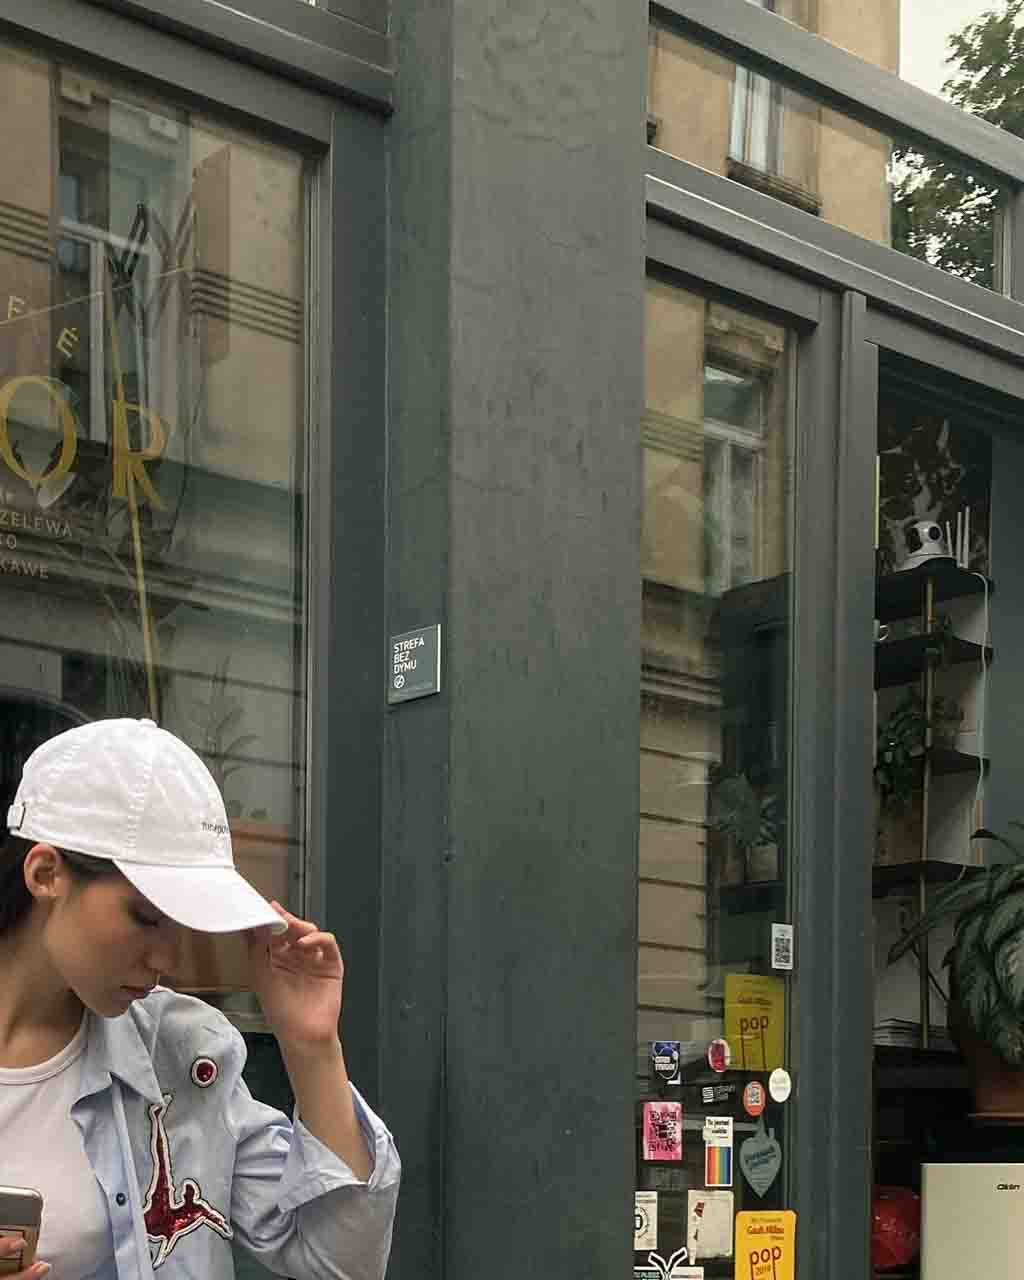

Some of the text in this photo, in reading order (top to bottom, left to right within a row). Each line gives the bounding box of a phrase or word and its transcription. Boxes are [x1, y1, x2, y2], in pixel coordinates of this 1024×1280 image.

[393, 636, 425, 653] STREFA
[393, 650, 410, 664] BEZ
[393, 659, 417, 675] DYMU
